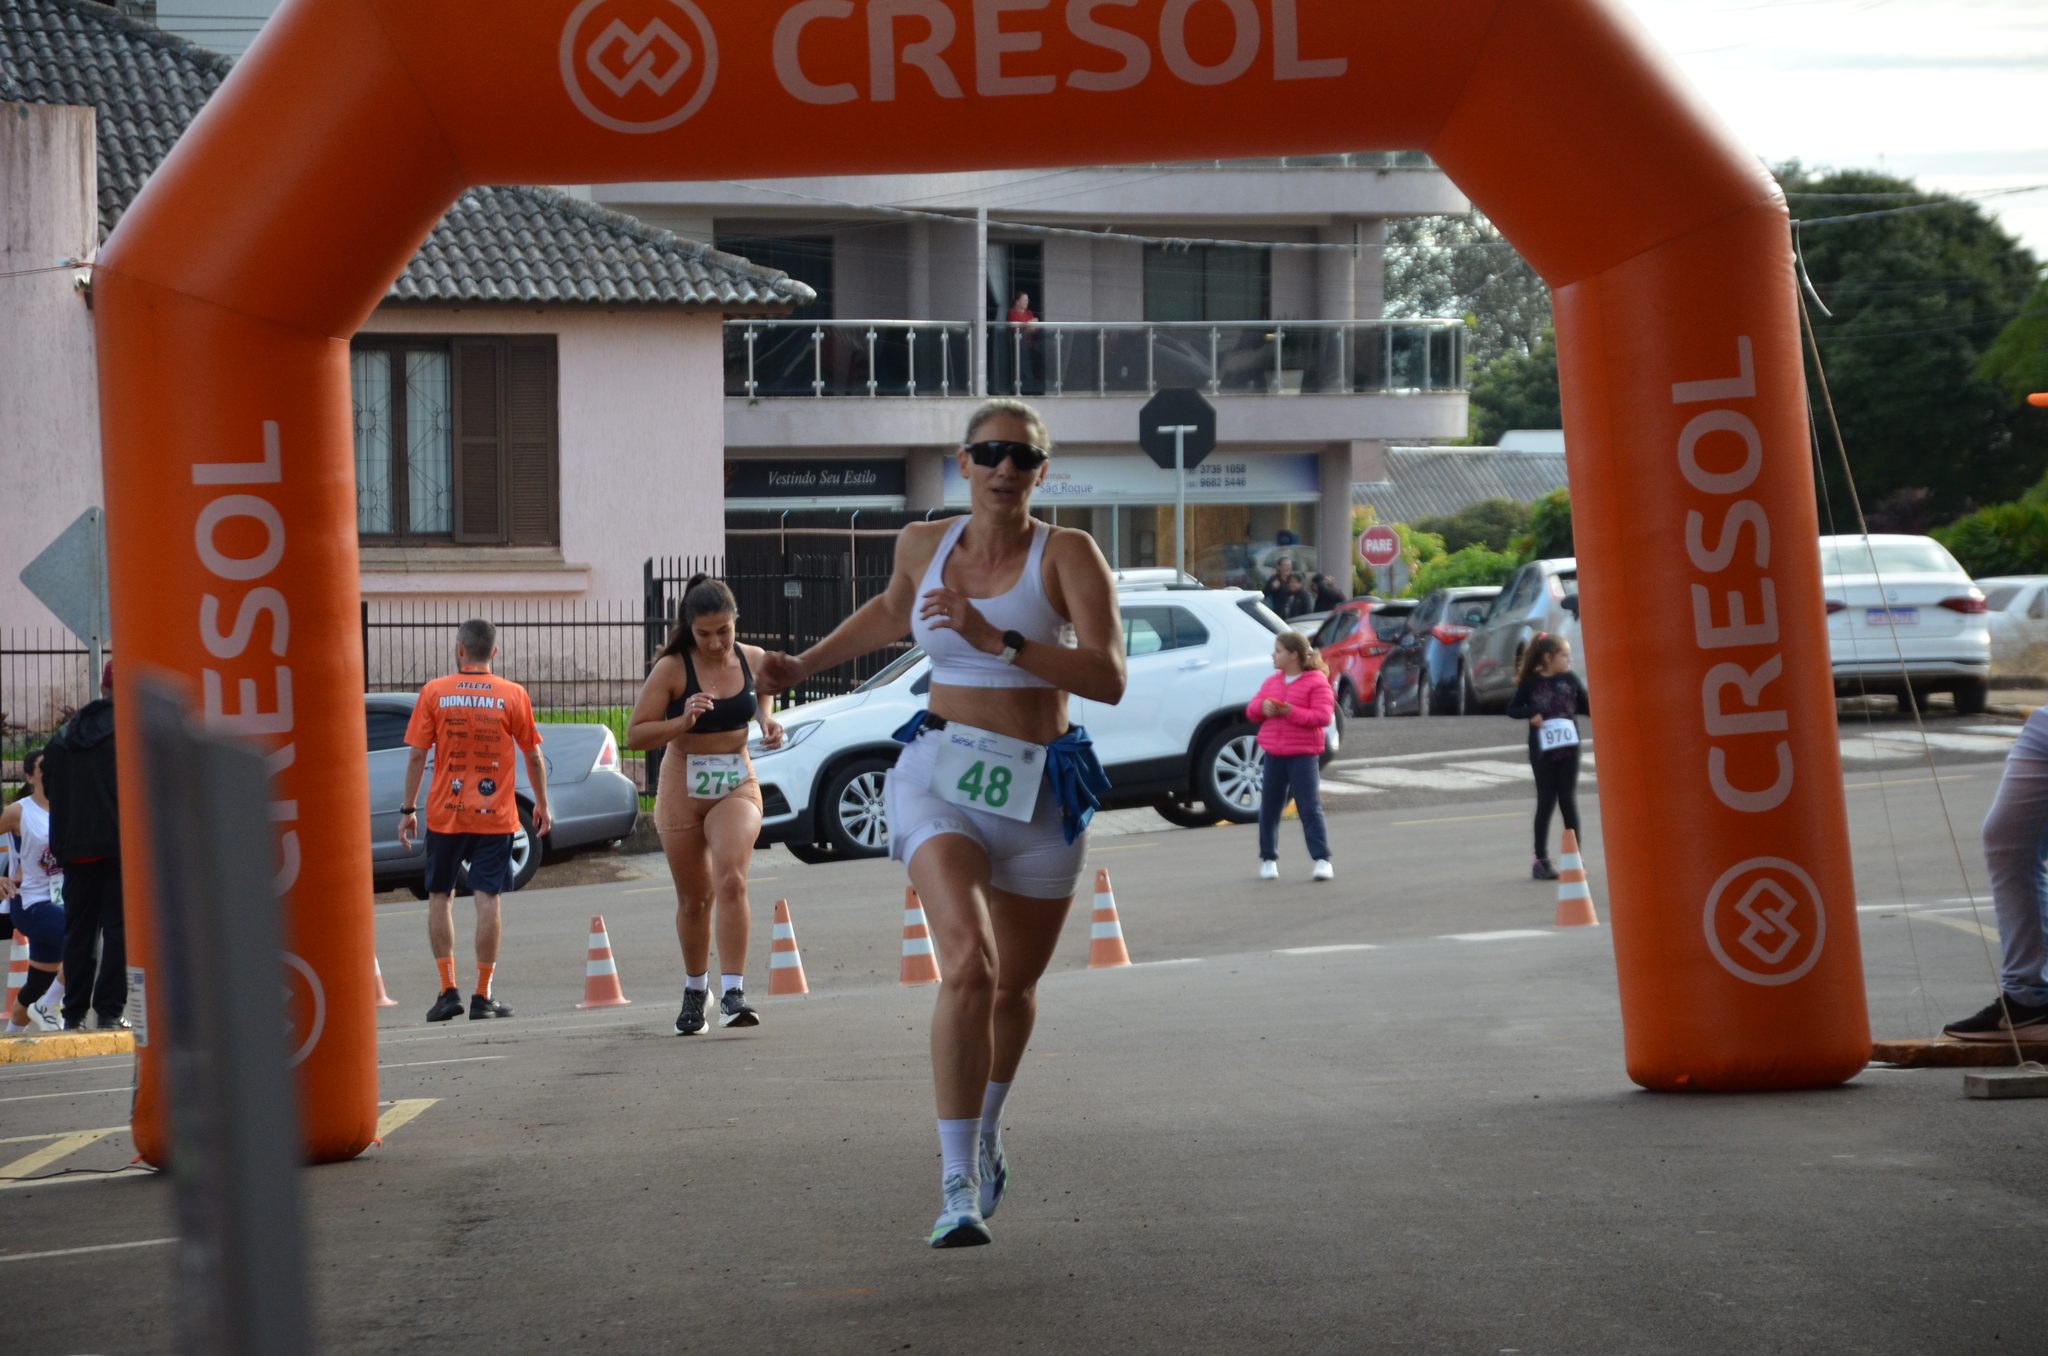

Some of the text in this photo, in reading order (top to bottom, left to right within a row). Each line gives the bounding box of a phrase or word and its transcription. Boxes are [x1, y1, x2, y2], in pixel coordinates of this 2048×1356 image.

[772, 0, 1348, 105] CRESOL
[1200, 464, 1221, 474] 3739
[1225, 463, 1247, 474] 1058
[768, 469, 877, 486] Vestindo Seu Estilo
[1200, 477, 1221, 488] 9682
[1224, 476, 1247, 487] 5446
[1061, 482, 1093, 495] Roque
[1366, 538, 1392, 552] PARE
[1672, 335, 1794, 813] CRESOL
[457, 682, 492, 690] ATLETA
[440, 695, 494, 709] DIONATAN
[1546, 728, 1572, 744] 970
[695, 771, 740, 794] 275
[957, 760, 1013, 808] 48
